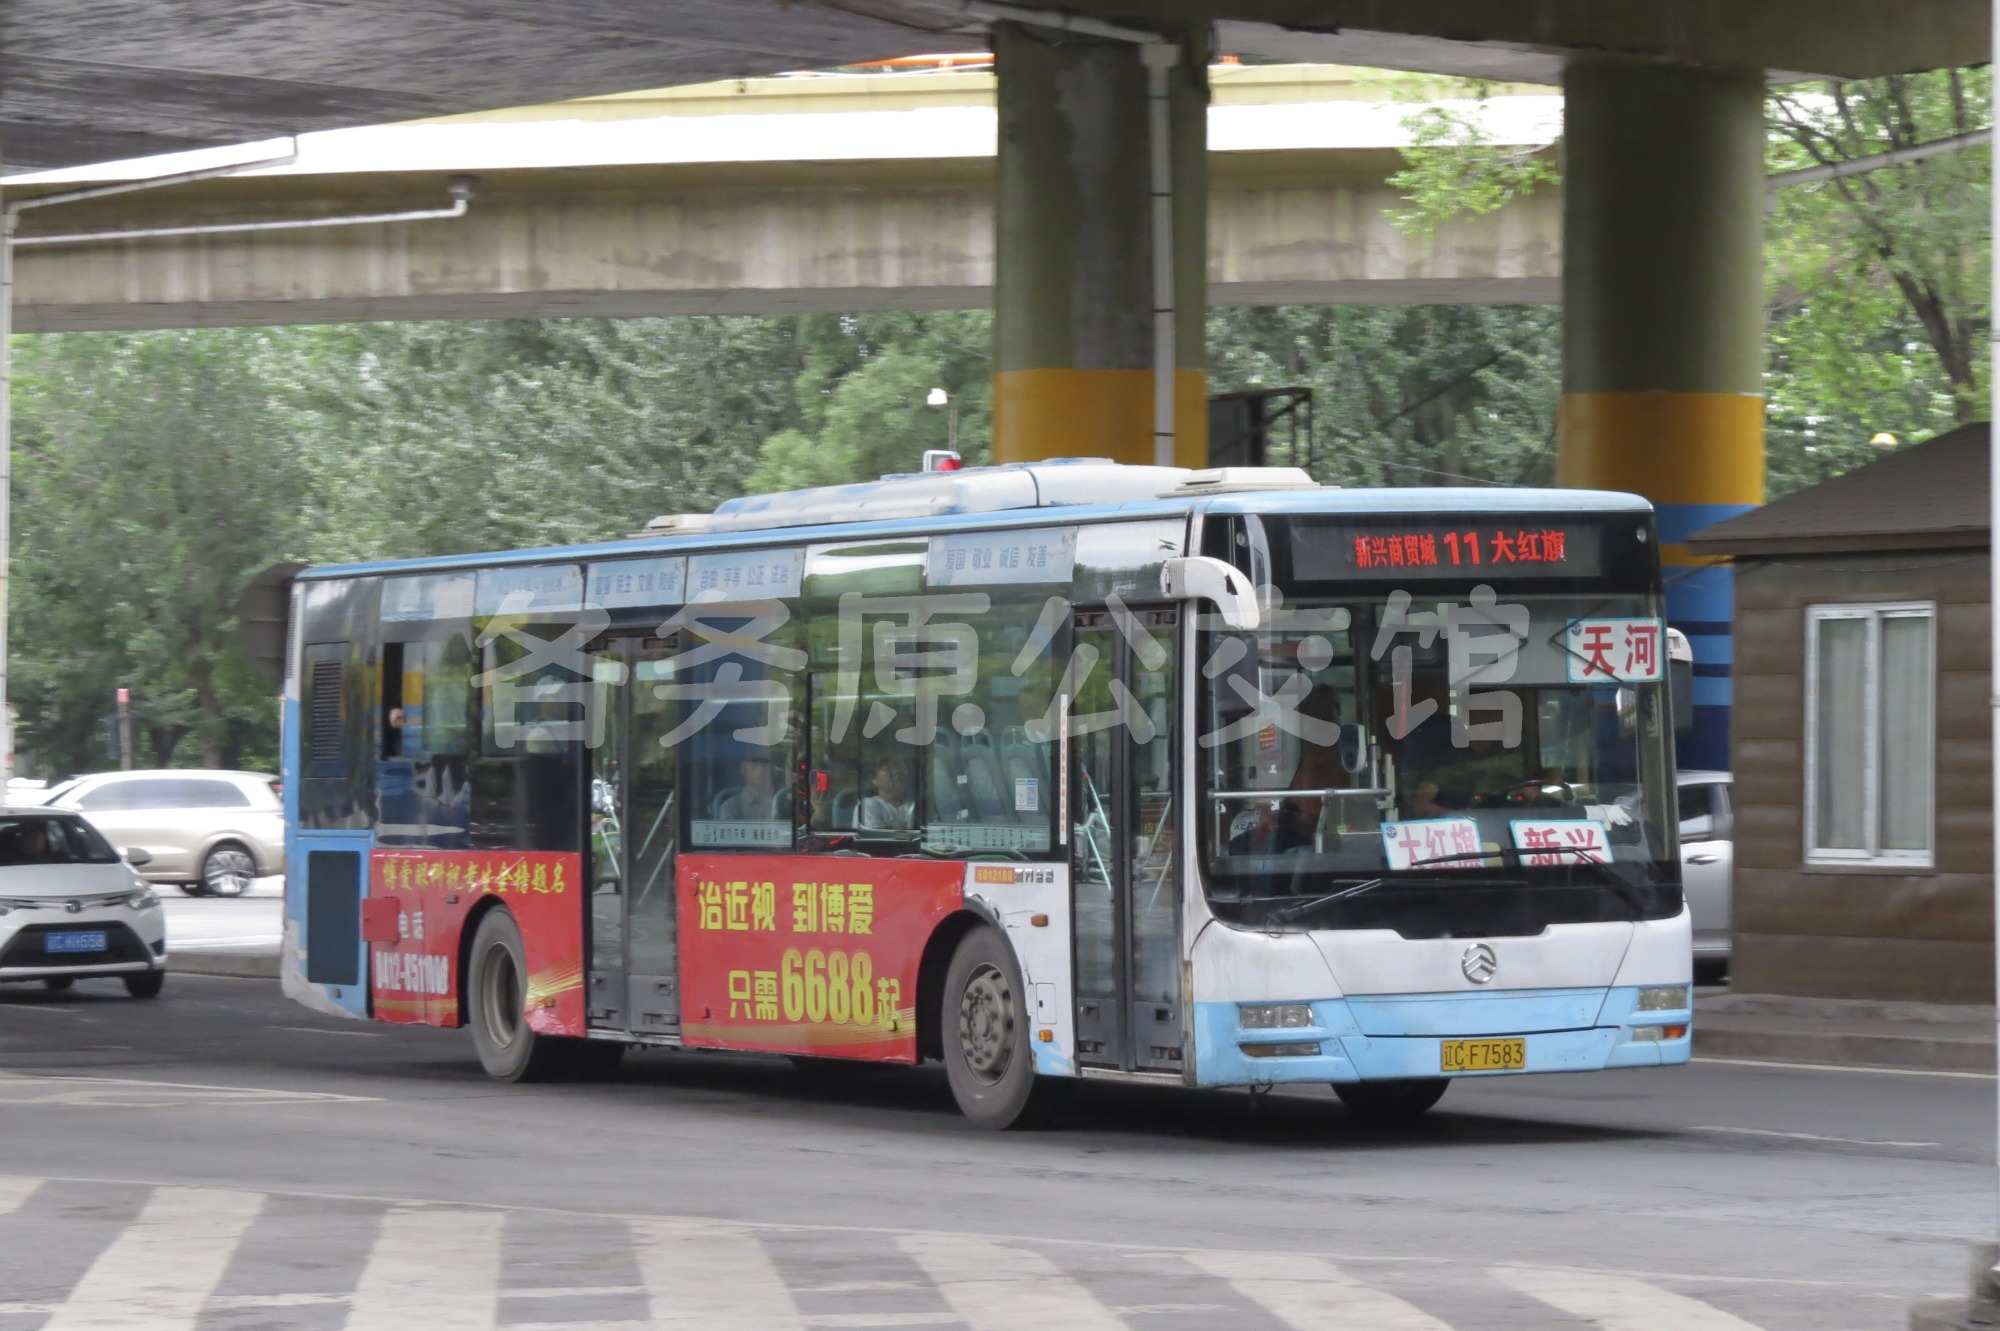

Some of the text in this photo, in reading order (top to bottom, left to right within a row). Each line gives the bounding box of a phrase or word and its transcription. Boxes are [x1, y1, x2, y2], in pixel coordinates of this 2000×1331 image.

[1026, 545, 1048, 567] 友善
[1354, 529, 1566, 568] 新兴商贸城 11 大红旗
[1583, 624, 1658, 677] 天河
[1399, 823, 1481, 869] 大红旗
[1523, 827, 1604, 867] 新兴
[699, 881, 874, 935] 治近视 到博爱
